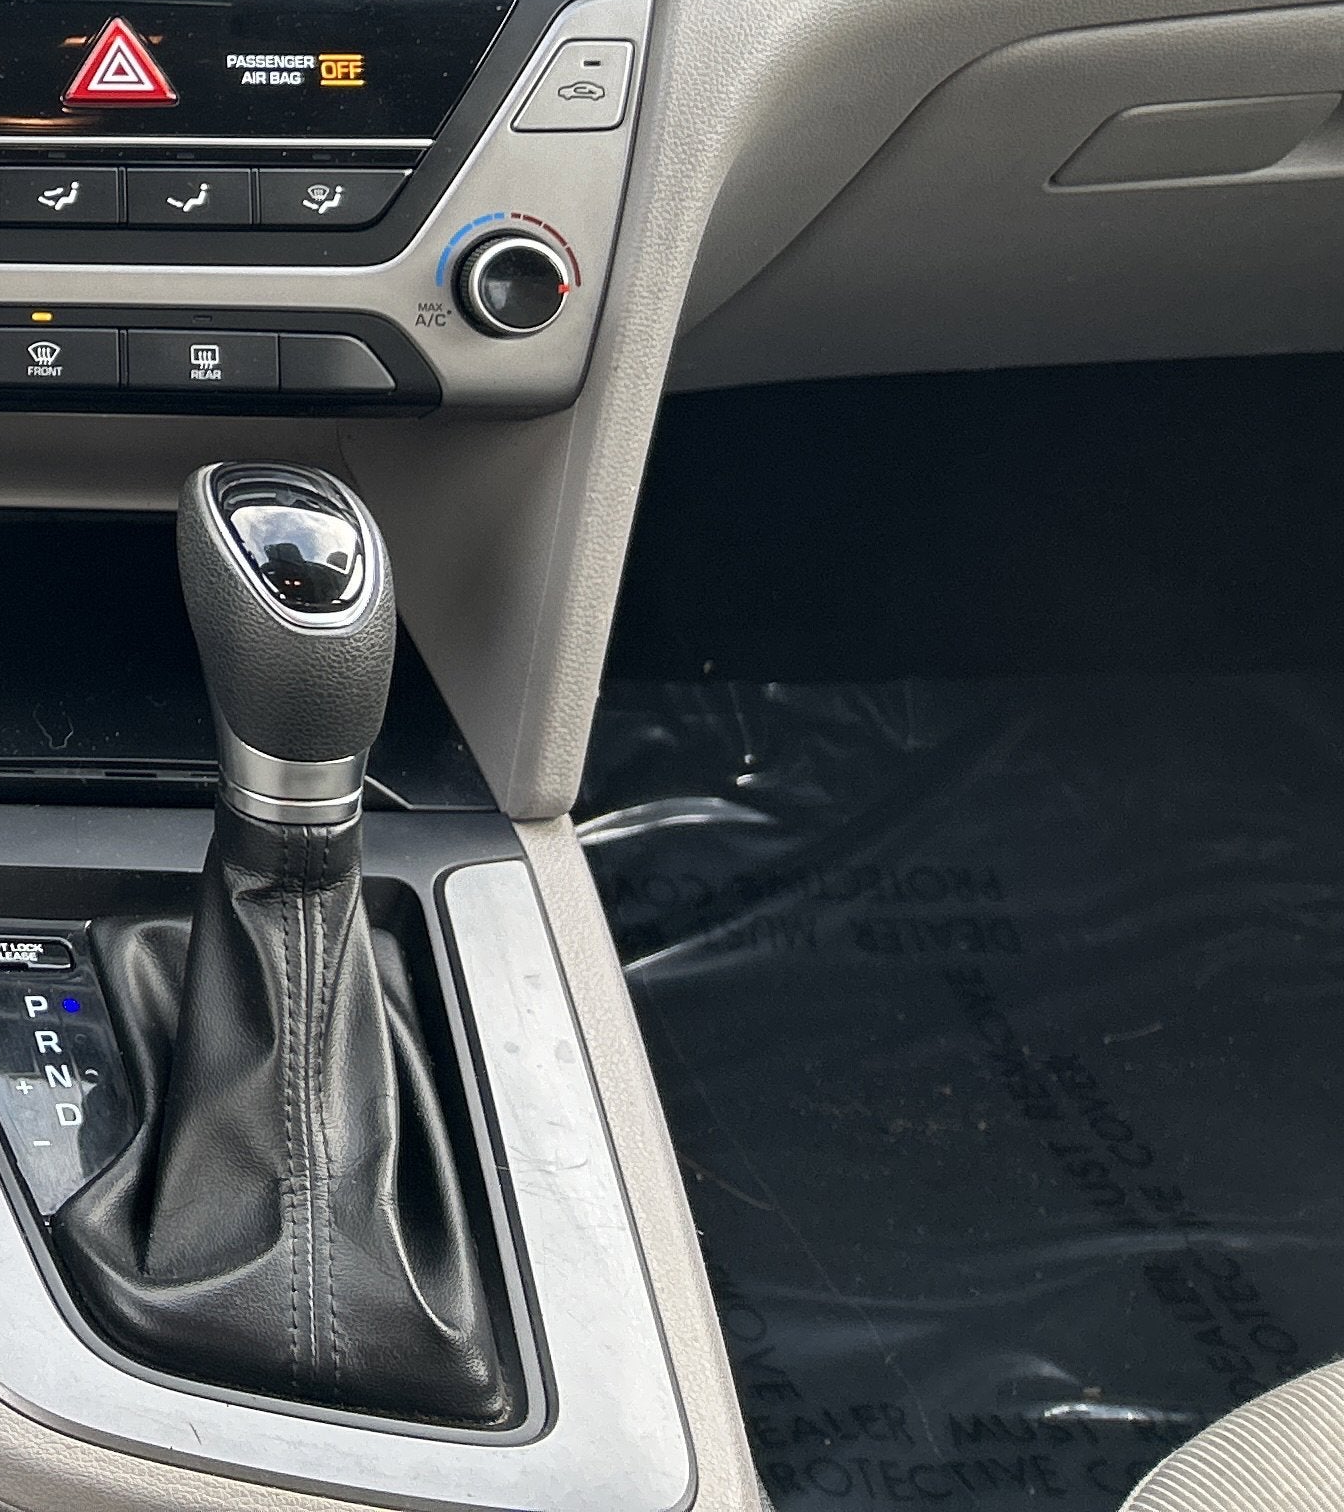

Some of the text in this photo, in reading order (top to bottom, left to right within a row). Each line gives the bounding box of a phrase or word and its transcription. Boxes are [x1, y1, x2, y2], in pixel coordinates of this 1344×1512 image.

[226, 54, 315, 69] PASSENGER
[241, 70, 302, 85] AIR BAG
[319, 61, 364, 79] OFF
[417, 302, 444, 313] MAX
[414, 312, 447, 328] A/C
[27, 365, 63, 377] FRONT
[190, 369, 222, 380] REAR
[10, 942, 44, 954] LOCK
[24, 995, 49, 1018] P
[34, 1030, 63, 1054] R
[44, 1064, 74, 1089] N
[55, 1102, 83, 1127] D
